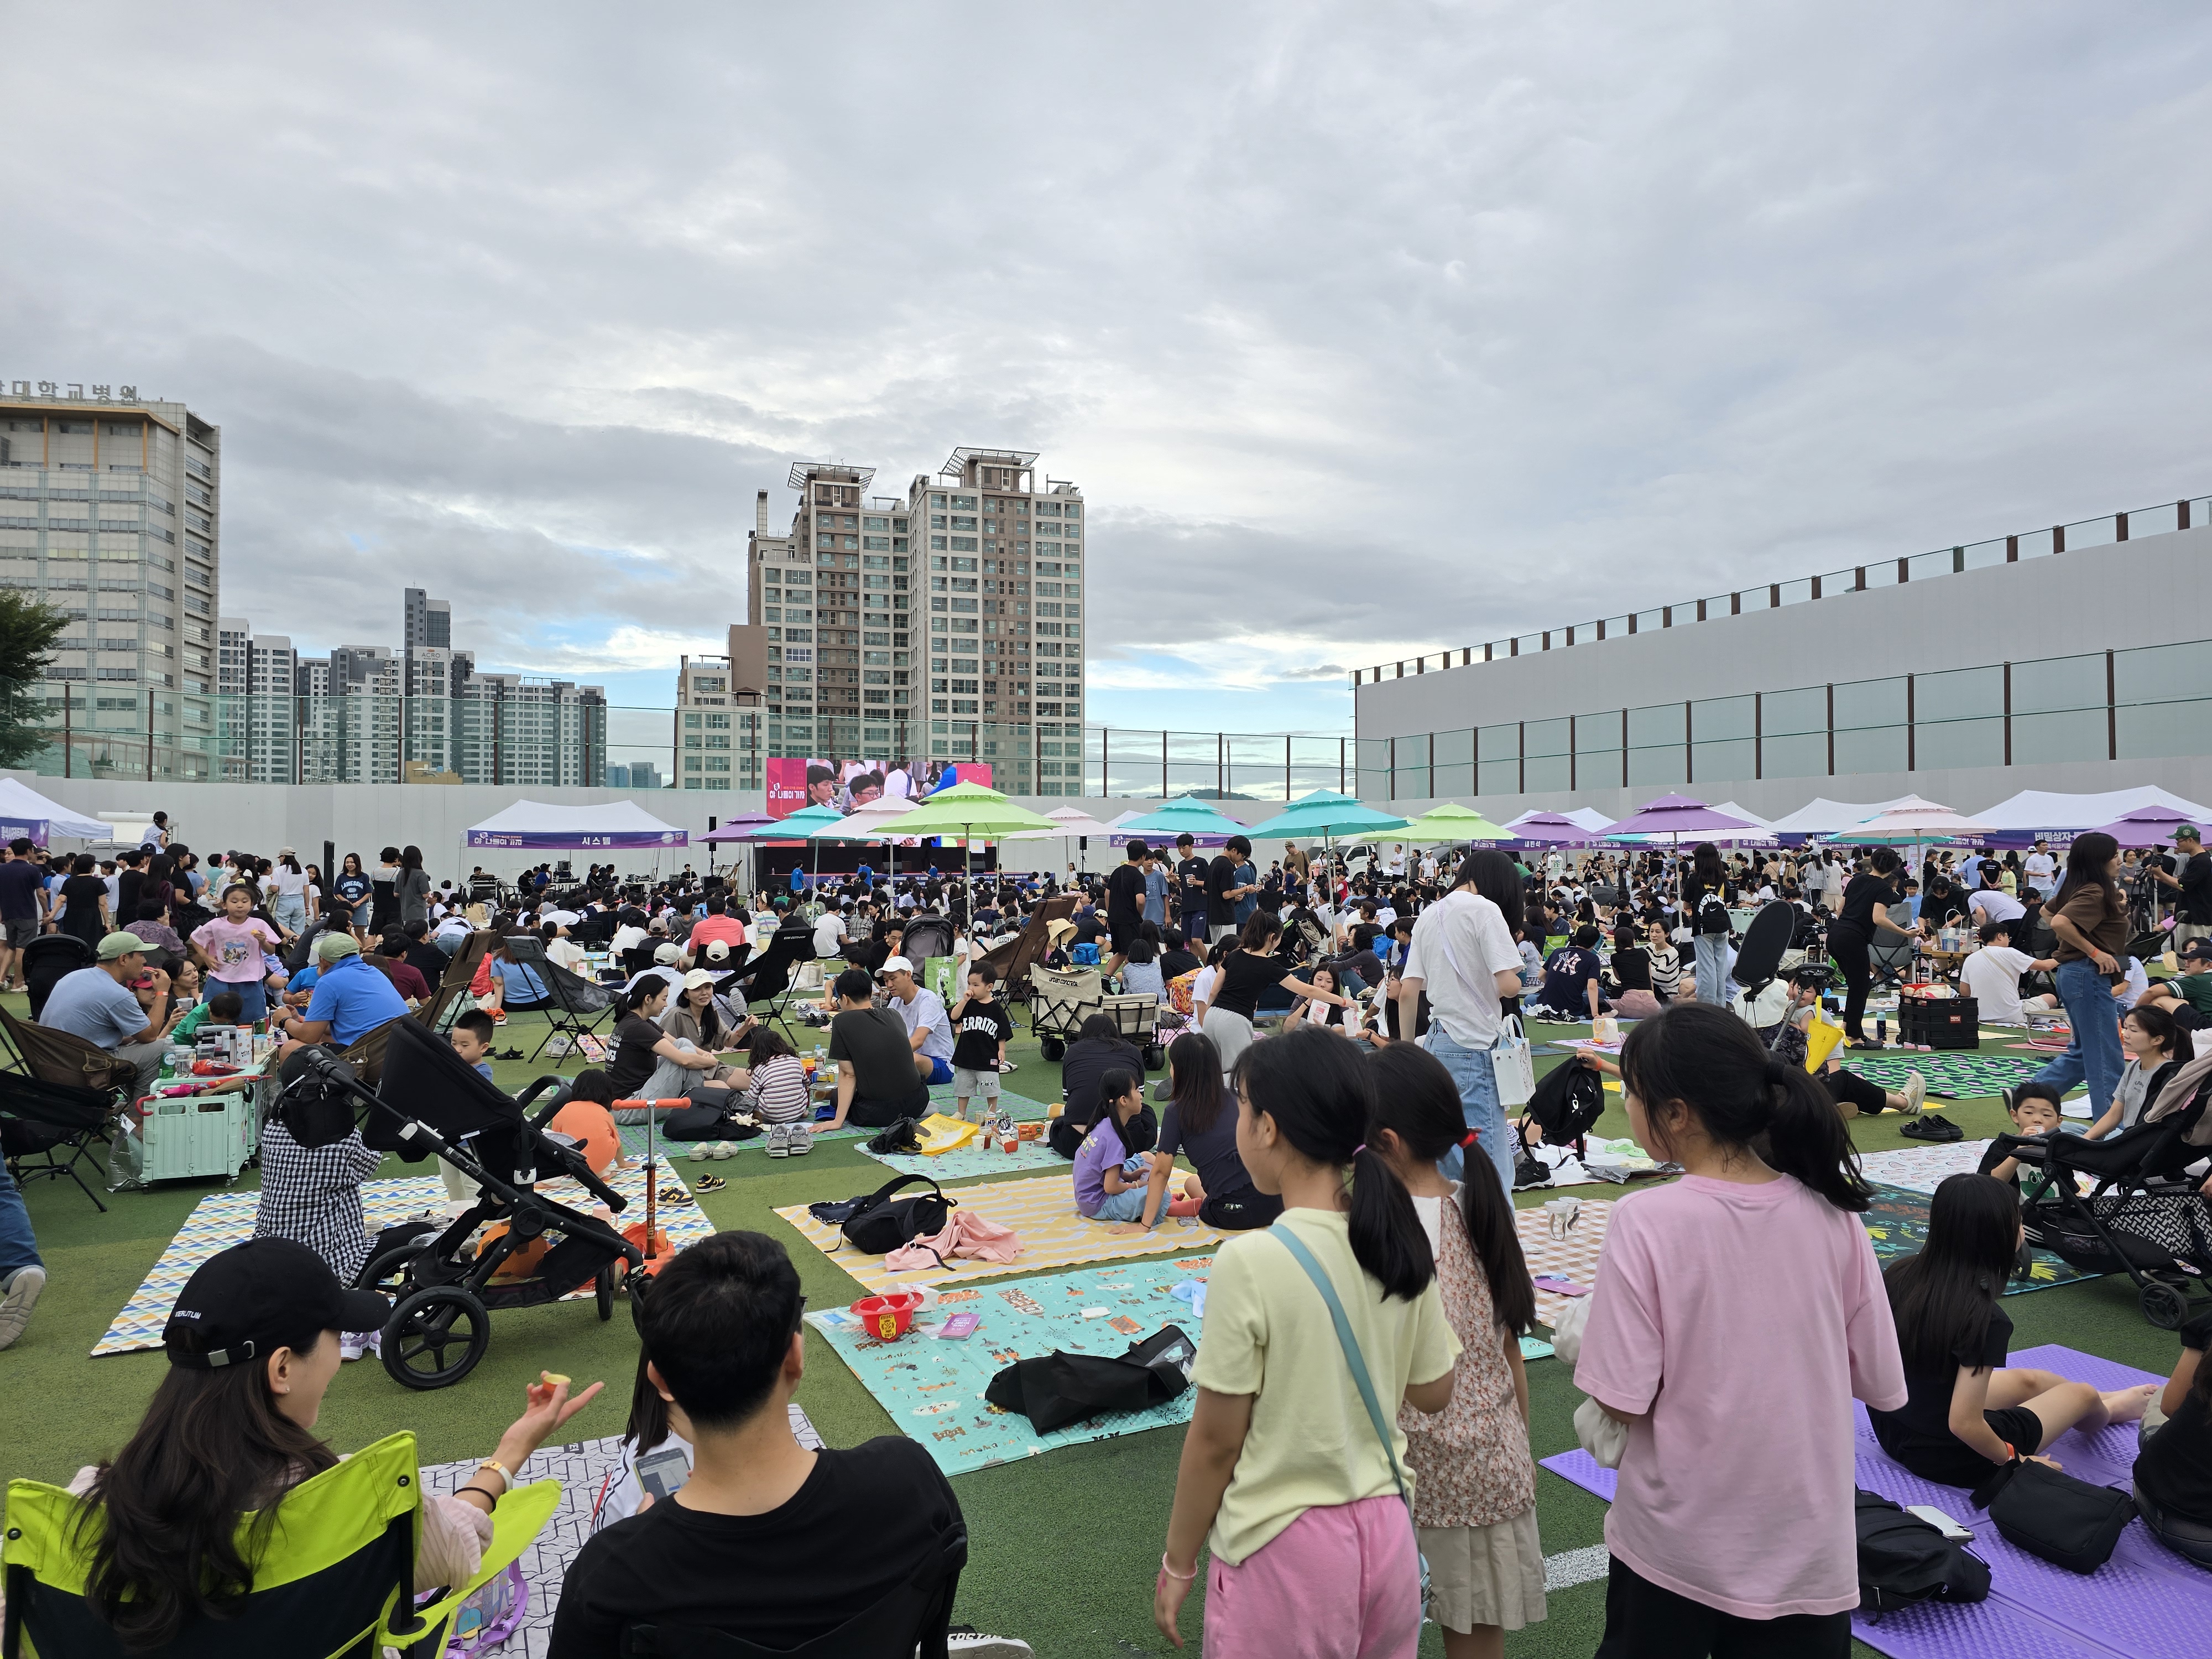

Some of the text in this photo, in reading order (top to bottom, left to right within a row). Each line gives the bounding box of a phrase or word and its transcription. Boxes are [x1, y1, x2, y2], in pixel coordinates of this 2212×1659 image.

[794, 790, 805, 799] 가자
[582, 837, 611, 846] 시스템
[2034, 832, 2071, 842] 비밀상자
[1553, 951, 1581, 975] NY
